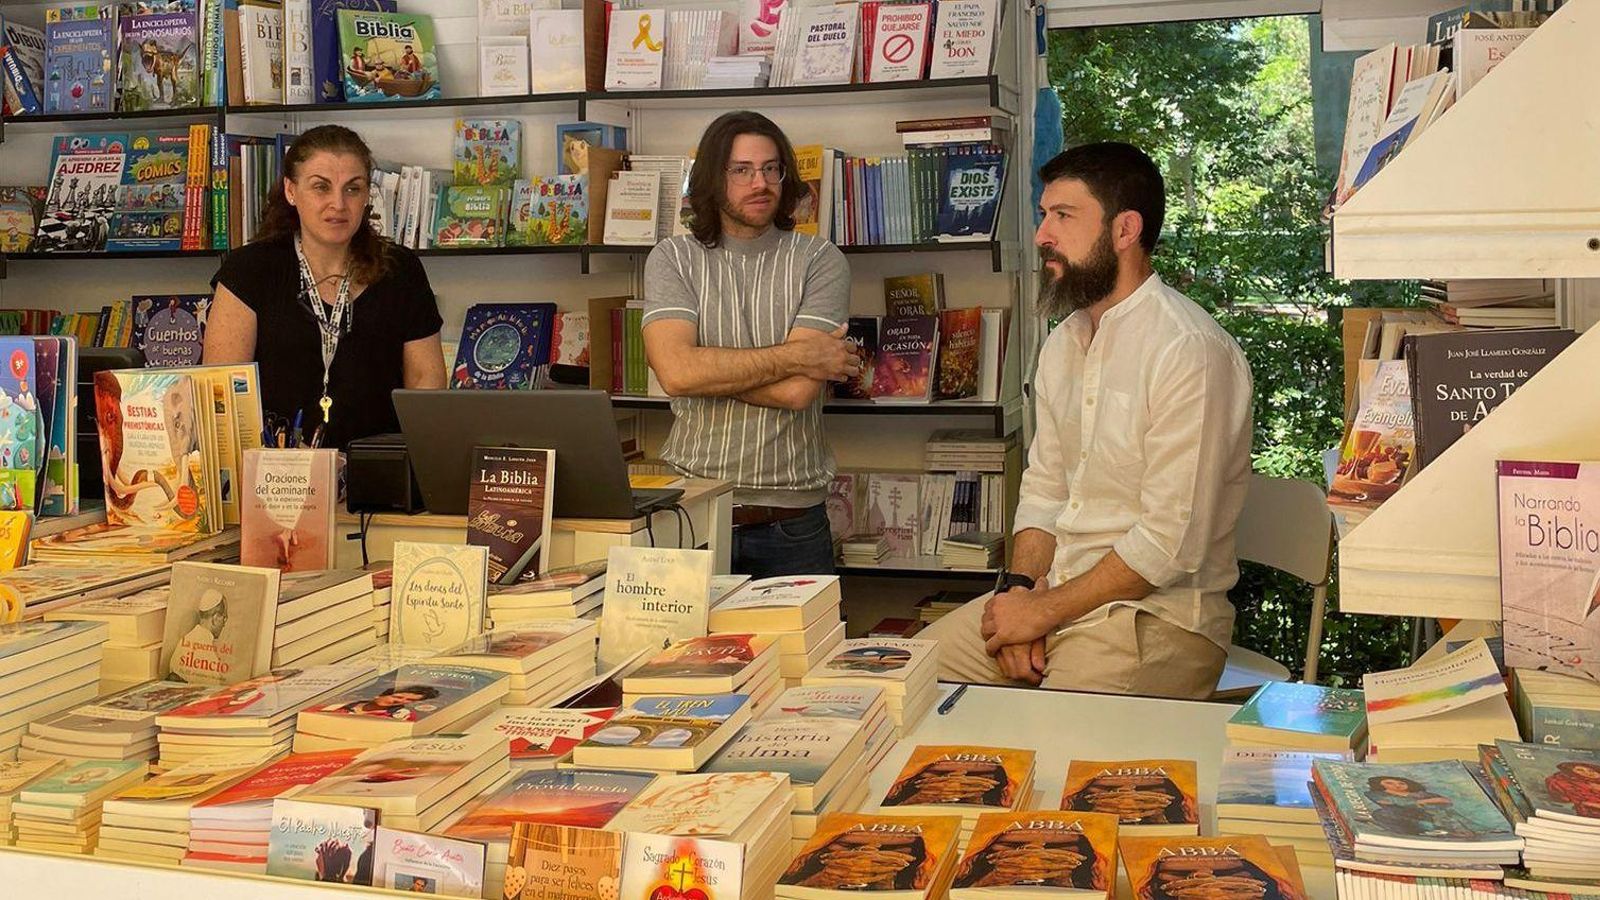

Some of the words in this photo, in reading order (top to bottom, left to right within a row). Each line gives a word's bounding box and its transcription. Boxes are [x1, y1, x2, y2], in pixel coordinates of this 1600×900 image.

[142, 18, 188, 27] ENCICLOPEDIA
[881, 13, 922, 22] PROHIBIDO
[141, 26, 192, 38] DINOSAURIOS
[354, 20, 414, 38] Biblia
[810, 22, 847, 33] PASTORAL
[881, 22, 920, 32] QUEJARSE
[807, 35, 820, 43] DEL
[823, 33, 847, 41] DUELO
[956, 30, 985, 38] MIEDO
[948, 47, 976, 58] DON
[465, 128, 510, 141] BIBLIA
[58, 162, 121, 174] AJEDREZ
[137, 159, 182, 182] CÓMICS
[959, 172, 989, 184] DIOS
[540, 183, 582, 196] BIBLIA
[951, 185, 995, 198] EXISTE
[148, 327, 198, 343] Cuentos
[886, 327, 910, 337] ORAD
[162, 346, 193, 356] buenas
[1447, 349, 1464, 360] JUAN
[1465, 349, 1480, 359] JOSÉ
[1512, 347, 1546, 356] GONZÁLEZ
[1470, 370, 1482, 380] La
[1484, 369, 1514, 379] verdad
[1517, 369, 1528, 378] de
[1436, 384, 1497, 401] SANTO
[127, 404, 157, 418] BESTIAS
[1451, 411, 1468, 421] DE
[264, 472, 308, 483] Oraciones
[480, 469, 496, 483] La
[500, 470, 538, 485] Biblia
[255, 485, 269, 495] del
[271, 484, 316, 496] caminante
[485, 485, 532, 494] LATINOAMÉRICA
[1514, 493, 1581, 512] Narrando
[1515, 517, 1526, 526] la
[1528, 514, 1600, 553] Biblia
[626, 572, 636, 582] El
[408, 581, 422, 592] Los
[424, 580, 447, 595] dones
[448, 582, 462, 595] del
[616, 580, 666, 596] hombre
[441, 596, 464, 610] Santo
[642, 598, 694, 614] interior
[181, 637, 192, 648] La
[193, 641, 218, 653] guerra
[219, 643, 233, 655] del
[180, 651, 229, 674] silencio
[494, 724, 571, 735] STRANGER
[738, 732, 831, 743] historia
[738, 746, 811, 758] alma
[515, 782, 629, 793] Providencia
[280, 816, 293, 834] El
[295, 817, 327, 836] Padre
[642, 845, 681, 865] Sagrado
[688, 850, 726, 871] Corazón
[541, 860, 561, 872] Diez
[563, 865, 587, 876] pasos
[663, 864, 675, 880] de
[530, 876, 550, 885] para
[552, 878, 565, 887] ser
[567, 876, 594, 891] felices
[524, 887, 536, 897] en
[537, 886, 546, 899] el
